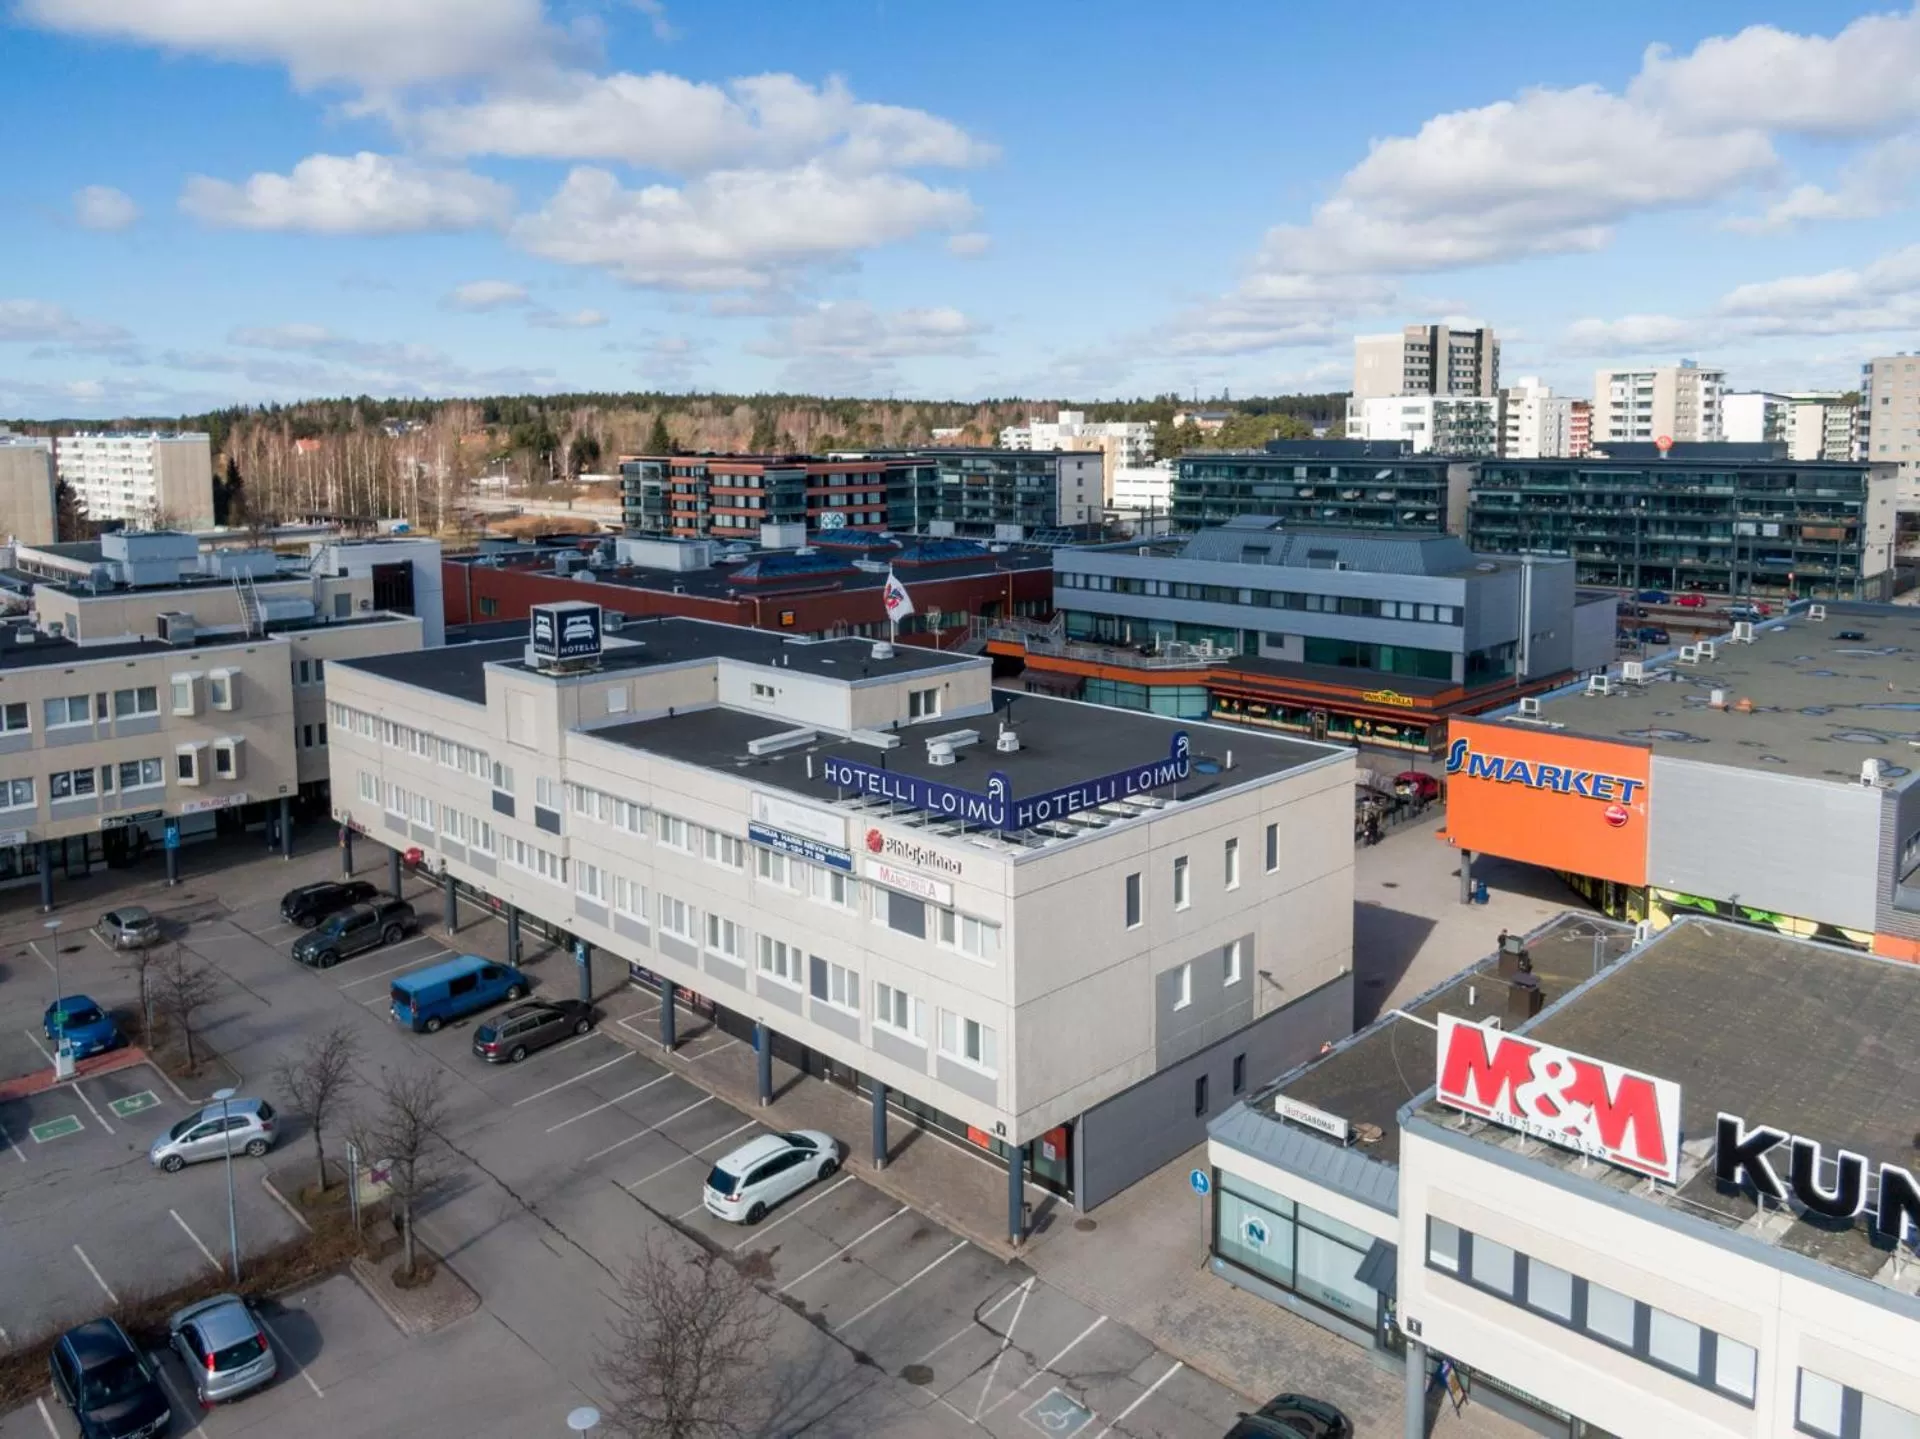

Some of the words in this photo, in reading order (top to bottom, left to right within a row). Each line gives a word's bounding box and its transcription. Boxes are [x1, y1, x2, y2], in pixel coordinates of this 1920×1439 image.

[560, 642, 599, 654] HOTELLI
[824, 762, 915, 802] HOTELLI
[927, 788, 1005, 826] LOIMU
[1018, 779, 1115, 827] HOTELLI
[1127, 757, 1190, 793] LOIMU
[1468, 752, 1645, 804] MARKET
[1440, 1022, 1668, 1166] M&M
